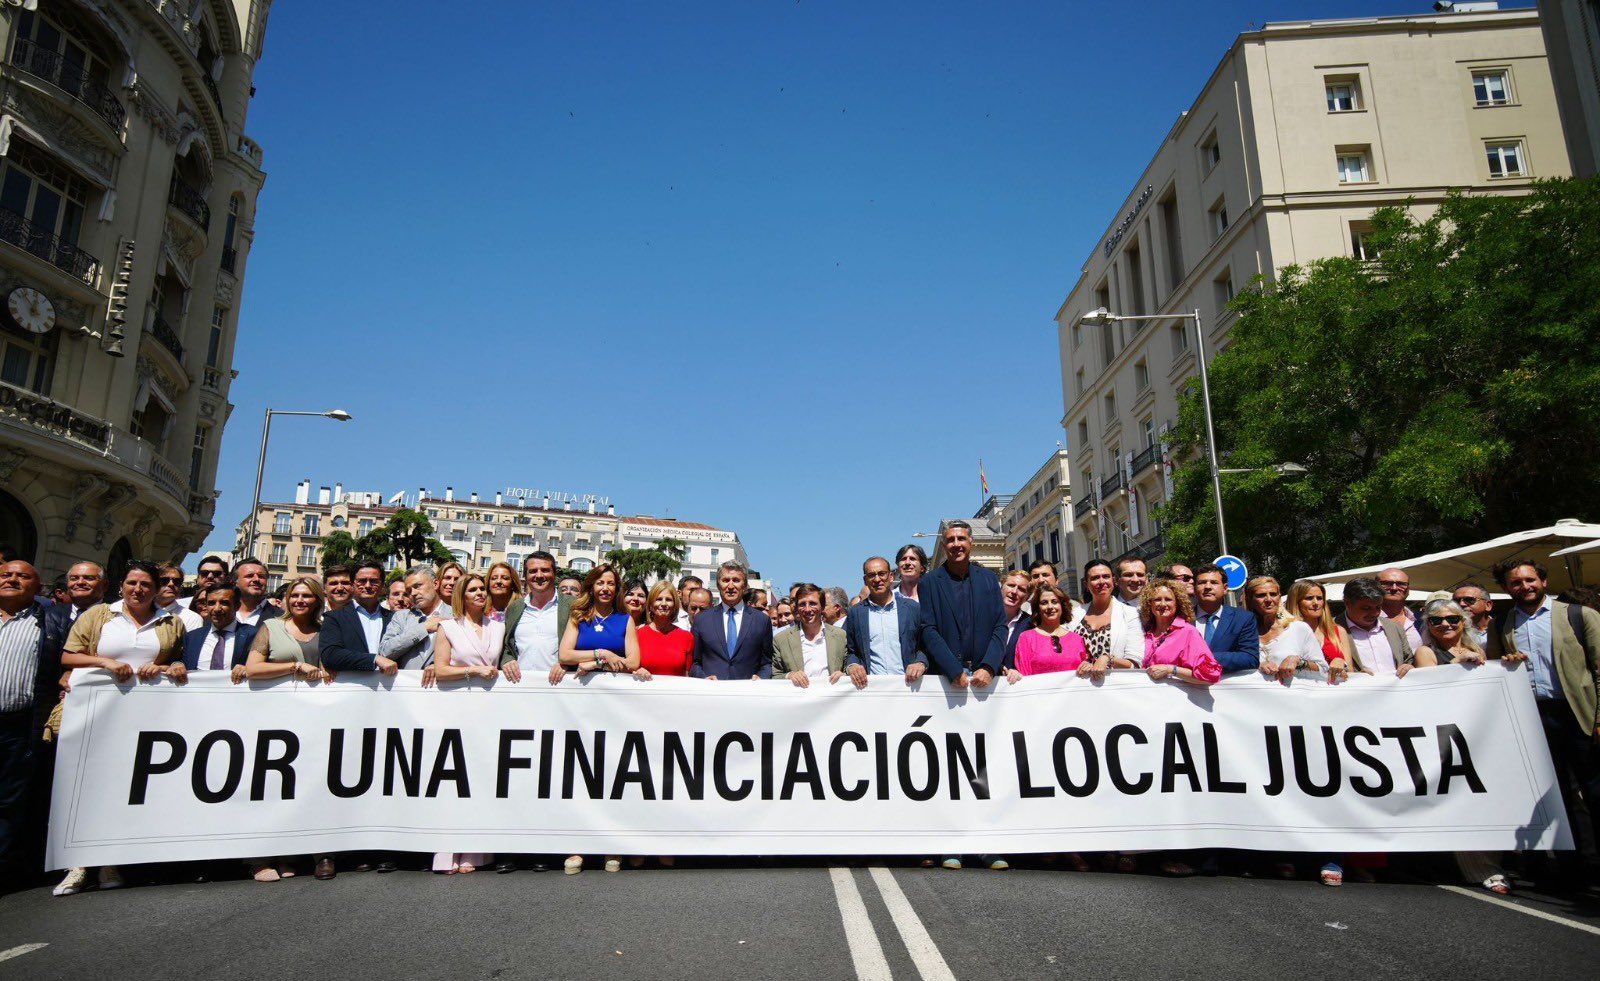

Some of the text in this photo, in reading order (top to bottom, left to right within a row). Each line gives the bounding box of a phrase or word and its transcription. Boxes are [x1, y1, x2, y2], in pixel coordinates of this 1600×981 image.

[506, 486, 541, 499] HOTEL
[547, 490, 578, 502] VILLA
[626, 525, 662, 534] ORGANIZACIÓN
[663, 527, 681, 535] MÉDICA
[682, 530, 705, 538] COLEGIAL
[128, 716, 1488, 805] POR UNA FINANCIACIÓN LOCAL JUSTA
